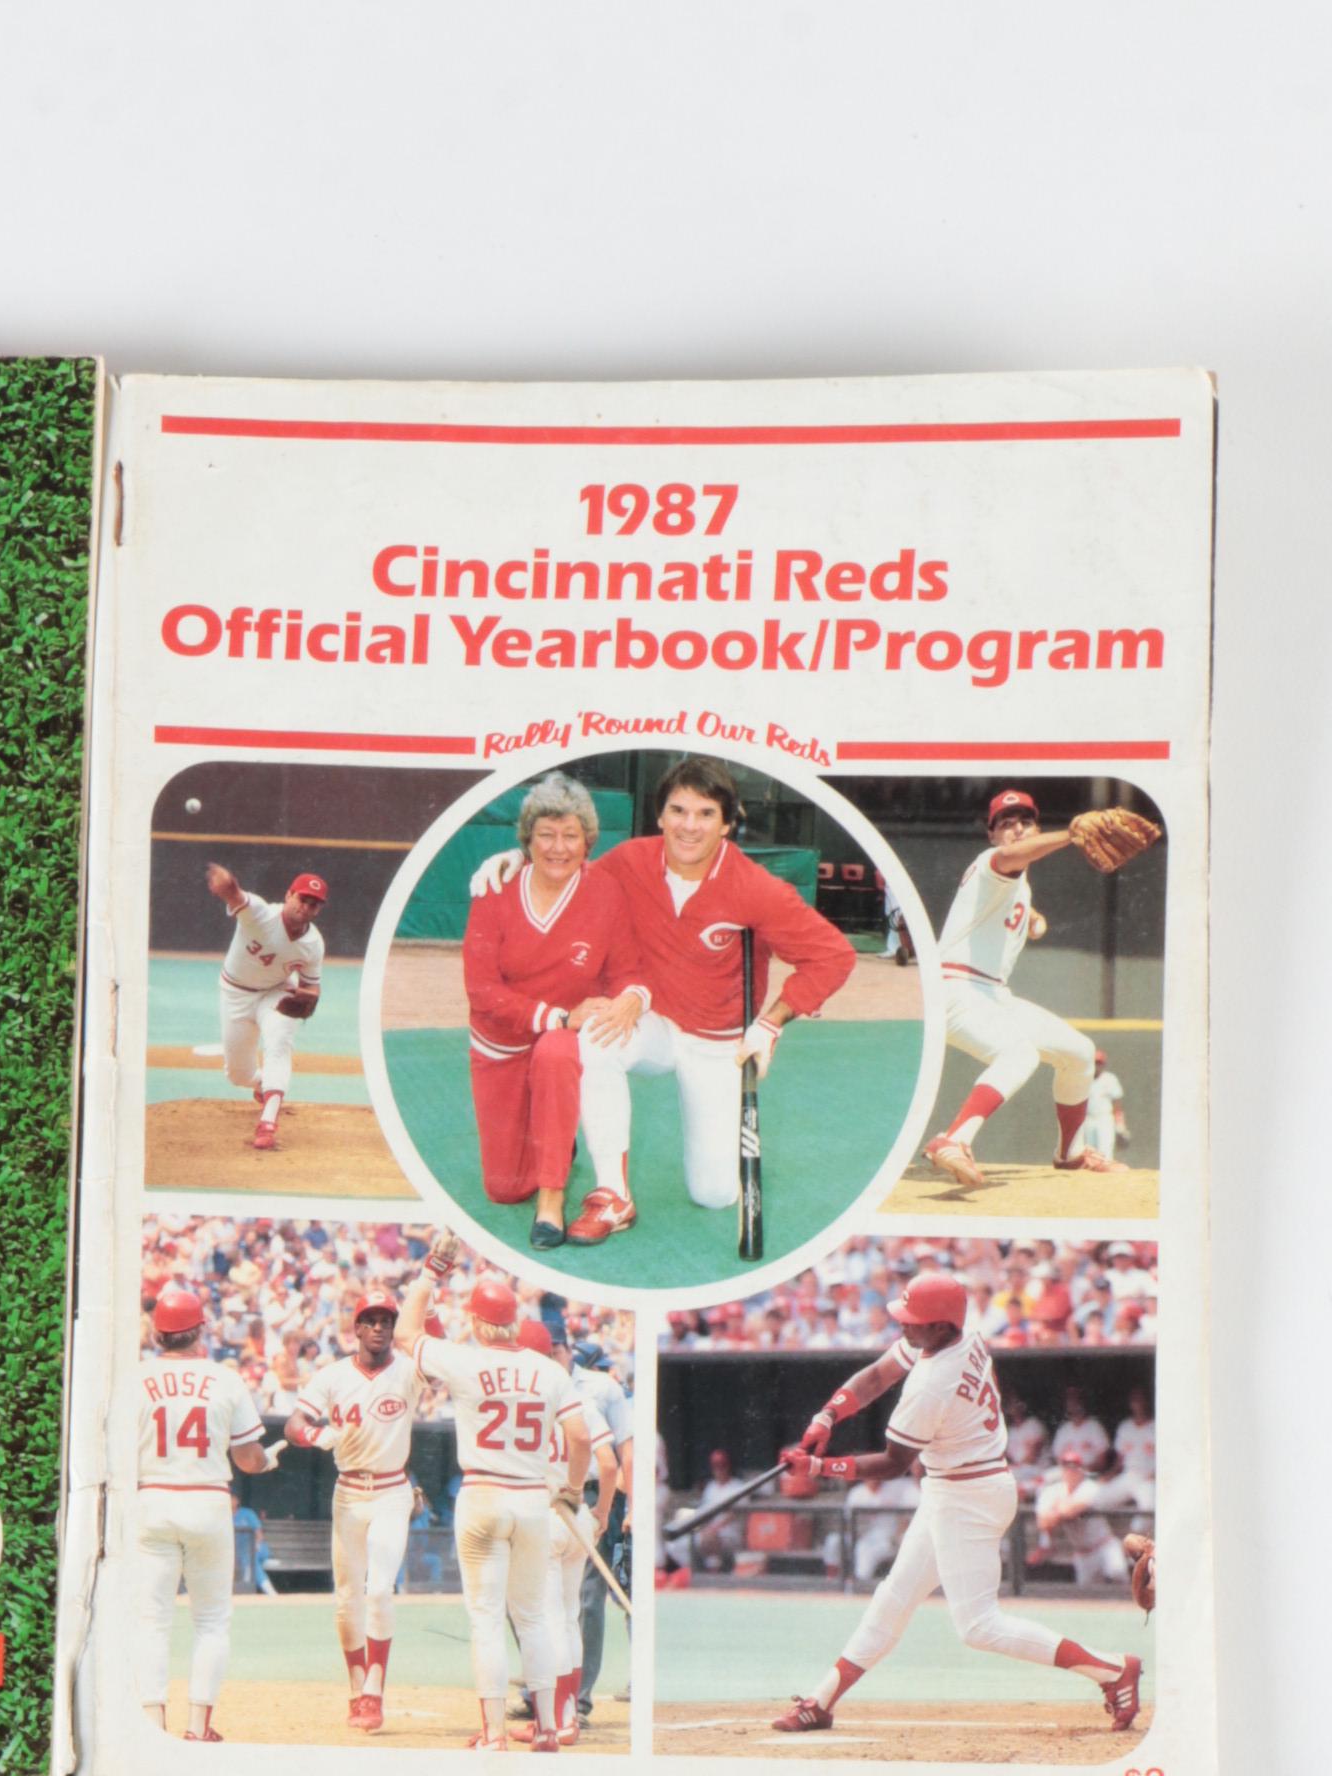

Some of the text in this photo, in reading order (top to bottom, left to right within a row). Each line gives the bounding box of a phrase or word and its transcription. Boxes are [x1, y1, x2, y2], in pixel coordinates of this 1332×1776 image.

[579, 483, 740, 537] 1987
[372, 545, 950, 602] Cincinnati Reds
[160, 604, 1165, 689] Official Yearbook/Program
[483, 719, 572, 760] Rally
[696, 710, 756, 744] Our
[765, 722, 832, 767] Reds
[246, 940, 277, 967] 34
[144, 1371, 217, 1402] ROSE
[479, 1369, 541, 1398] BELL
[152, 1406, 211, 1459] 14
[331, 1402, 362, 1428] 44
[475, 1400, 545, 1452] 25
